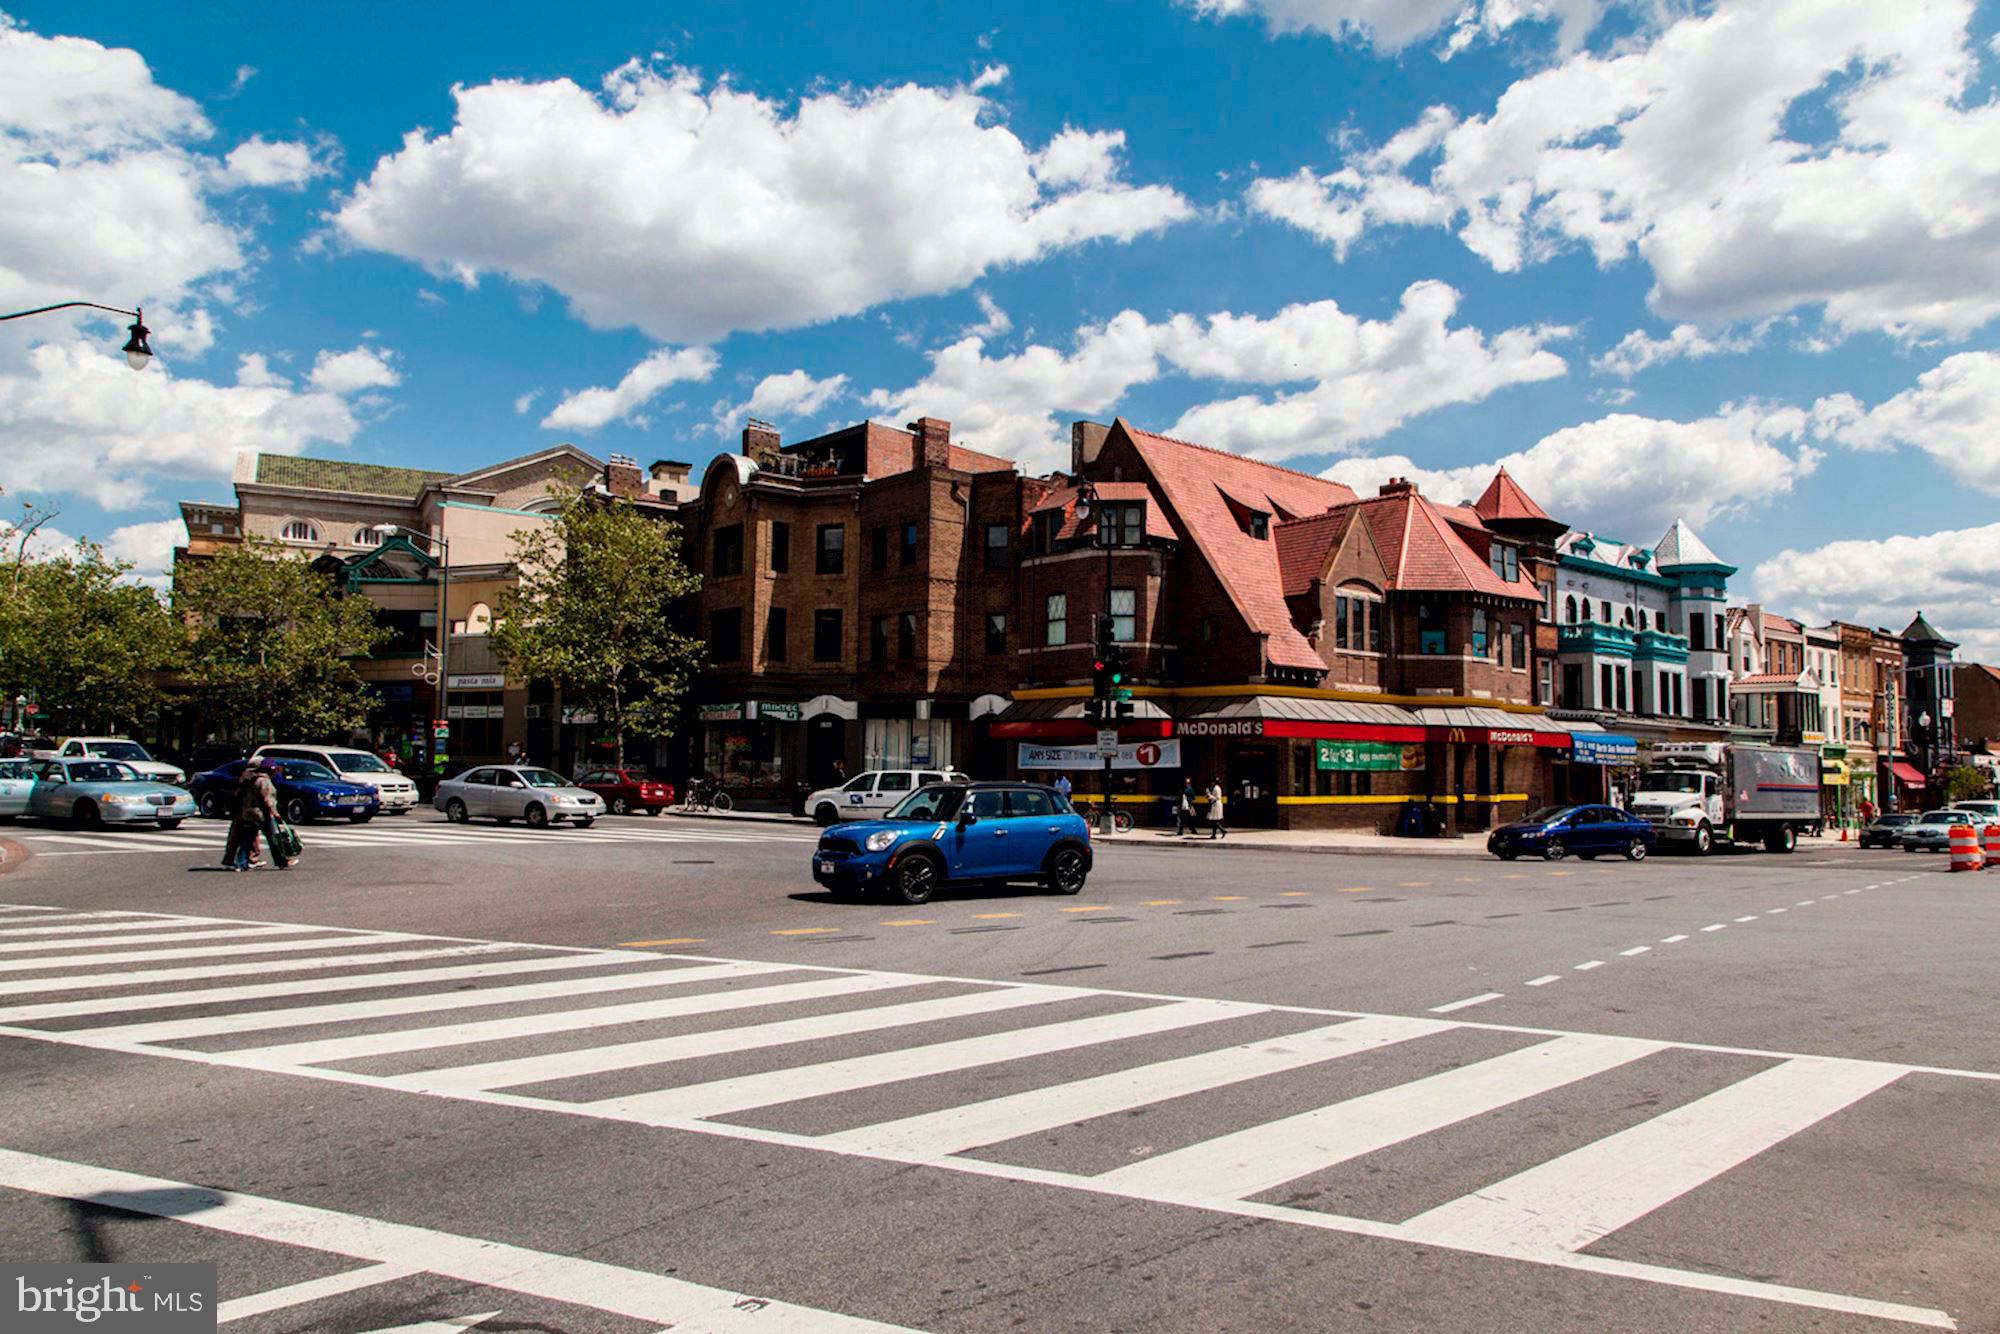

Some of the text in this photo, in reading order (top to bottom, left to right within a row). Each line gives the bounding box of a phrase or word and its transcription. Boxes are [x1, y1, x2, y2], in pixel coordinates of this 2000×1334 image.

[1177, 721, 1263, 735] McDonald's
[1490, 731, 1533, 743] McDonald's
[1028, 750, 1044, 760] ANY
[1045, 750, 1062, 760] SIZE
[1320, 748, 1329, 761] 2
[1340, 749, 1354, 762] $3
